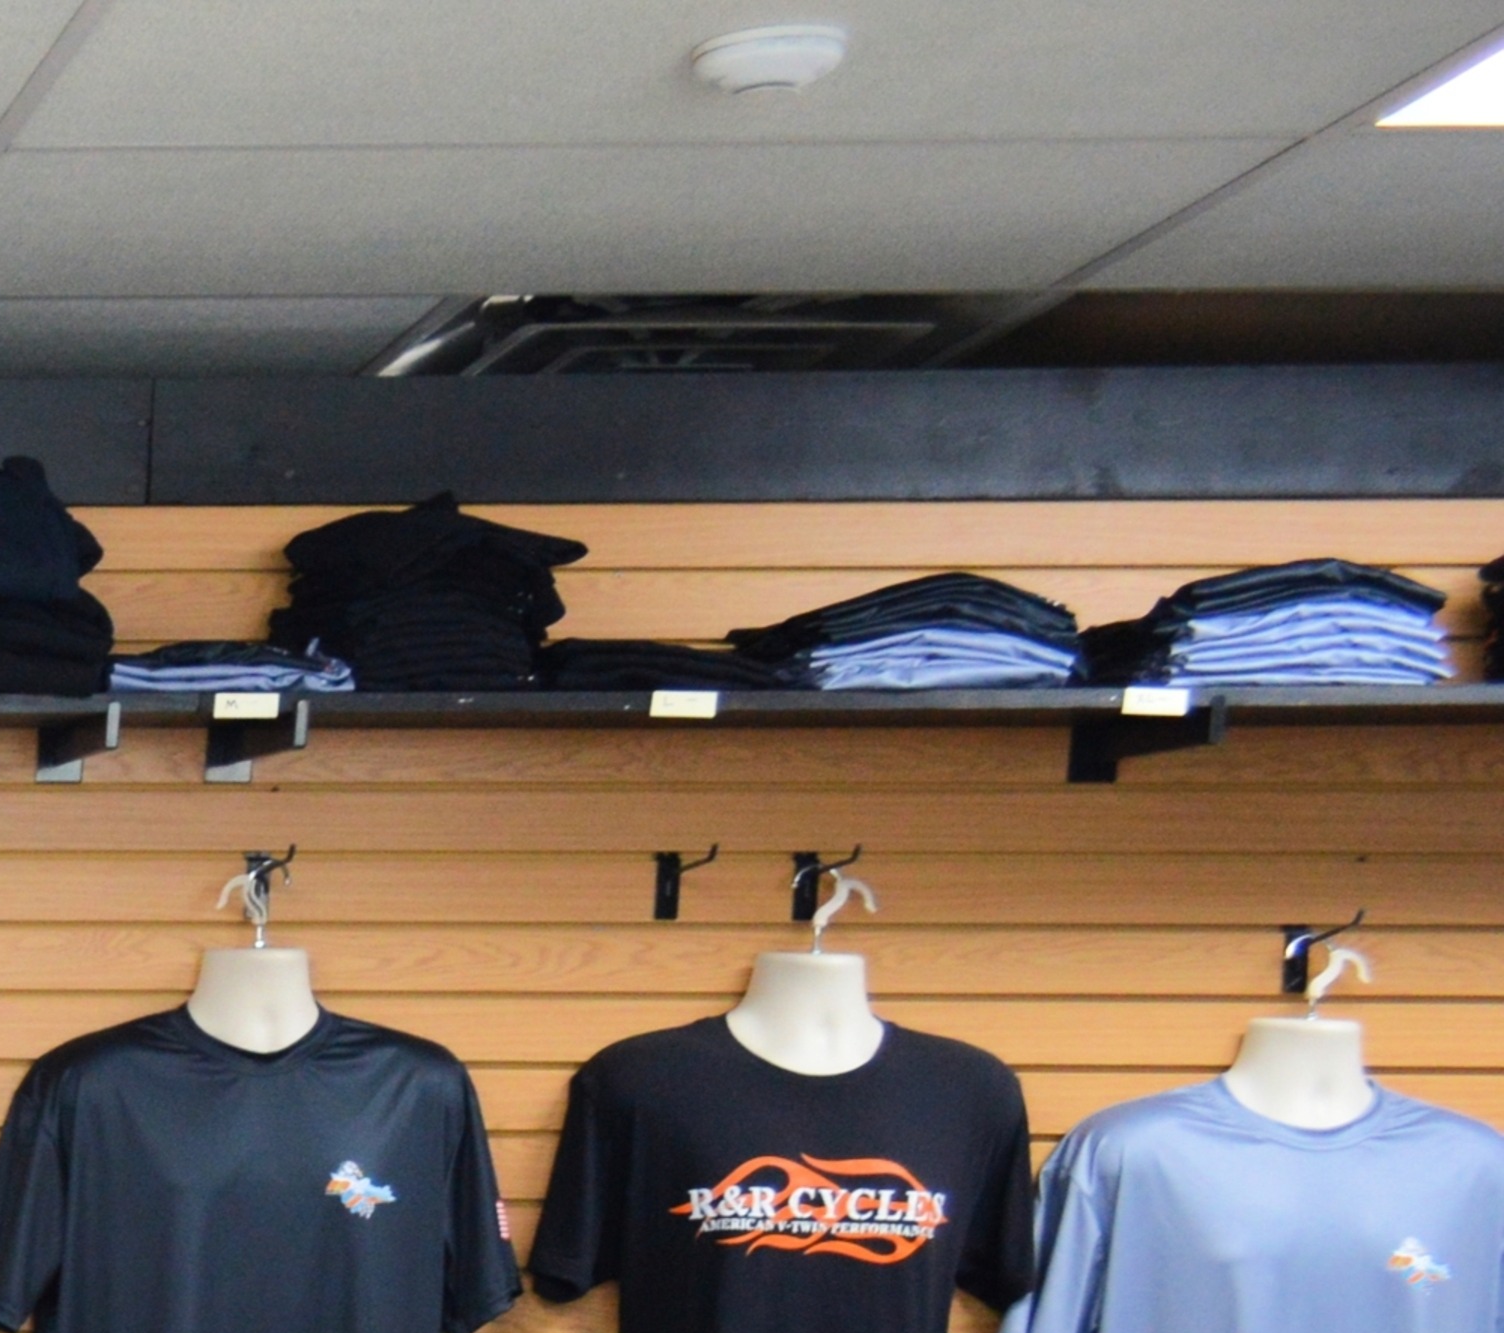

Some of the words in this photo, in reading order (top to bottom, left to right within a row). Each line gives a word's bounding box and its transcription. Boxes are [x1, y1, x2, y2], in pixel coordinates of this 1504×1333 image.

[687, 1184, 778, 1220] R&R
[788, 1186, 948, 1223] CYCLES
[700, 1218, 775, 1233] AMERICAN
[776, 1219, 828, 1234] V-TWIN
[830, 1221, 937, 1240] PERFORMANCE
